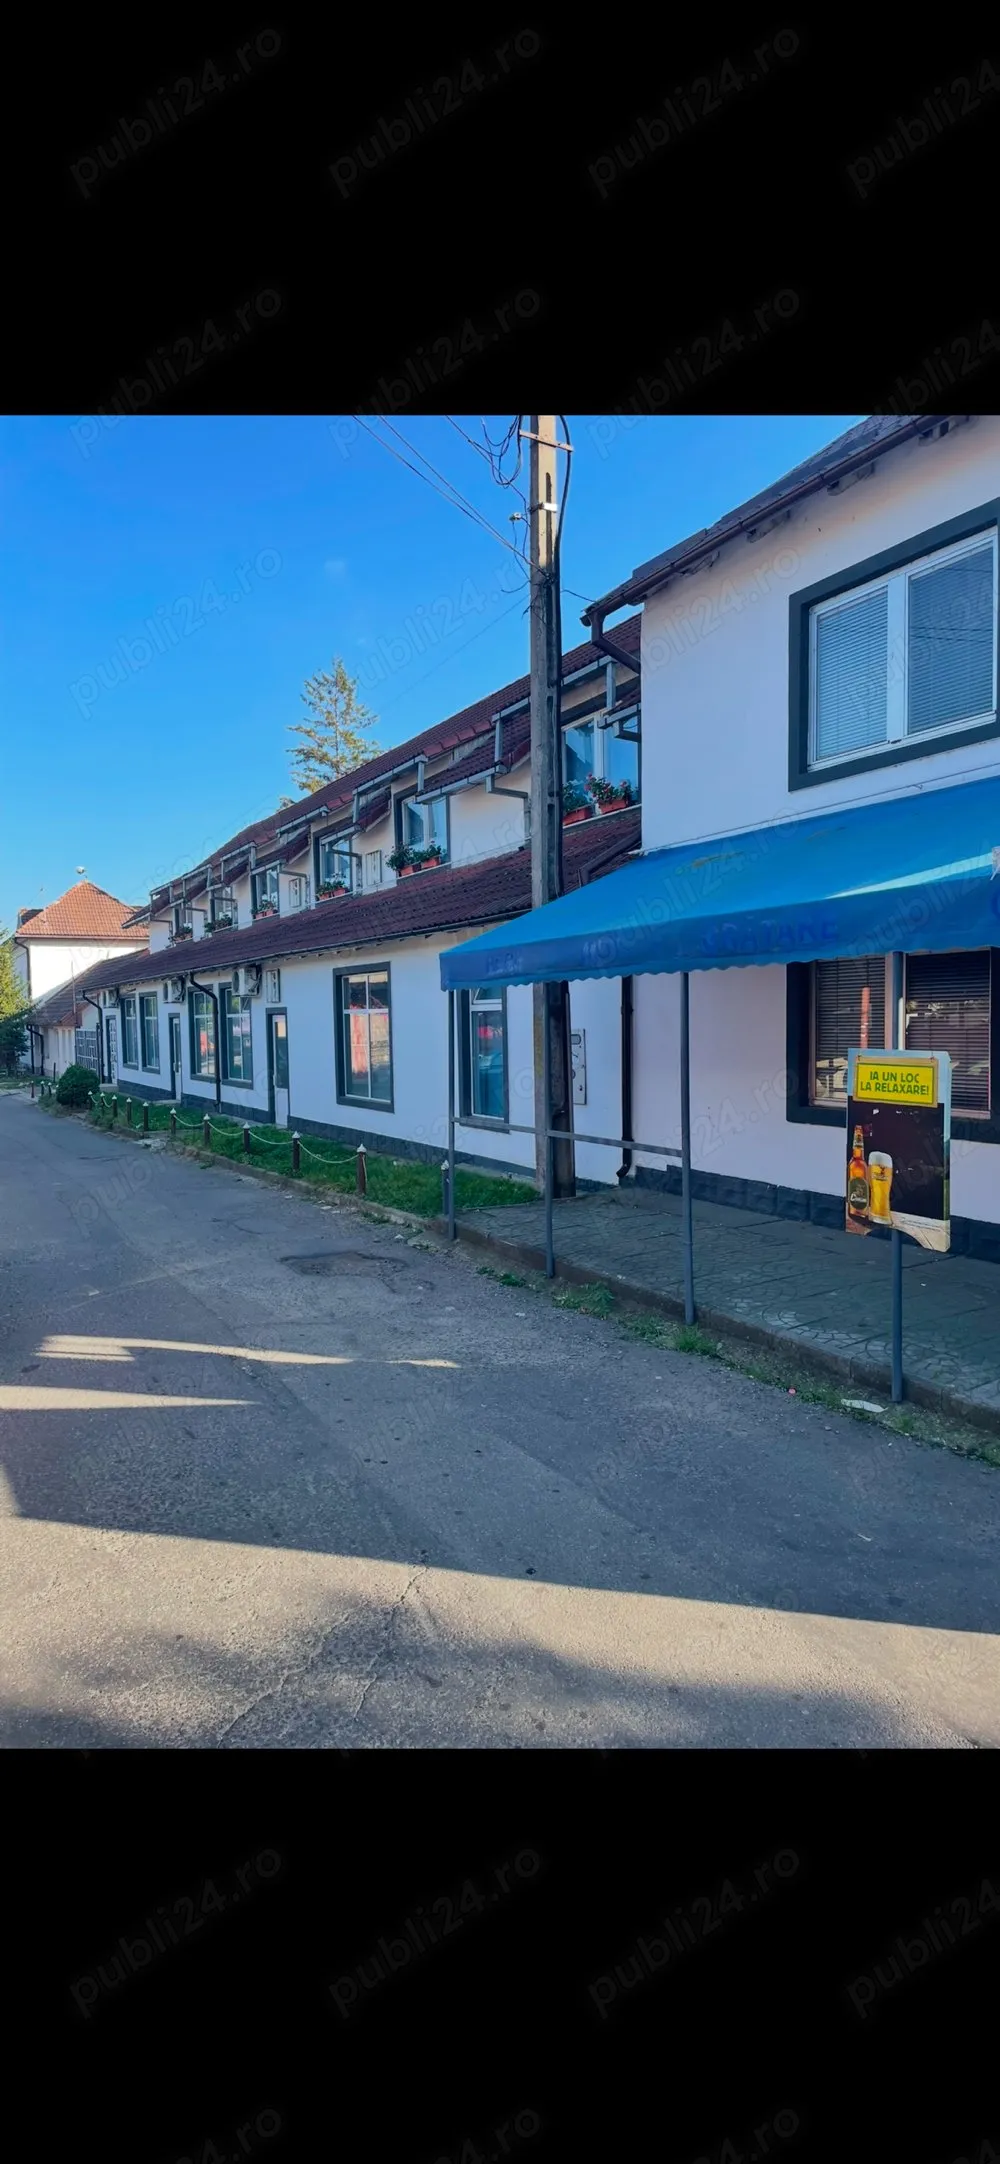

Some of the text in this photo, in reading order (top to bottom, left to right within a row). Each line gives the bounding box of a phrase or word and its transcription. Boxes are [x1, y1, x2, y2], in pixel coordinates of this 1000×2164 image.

[870, 1071, 919, 1083] IA UN LOC
[860, 1081, 929, 1095] LA RELAXARE!
